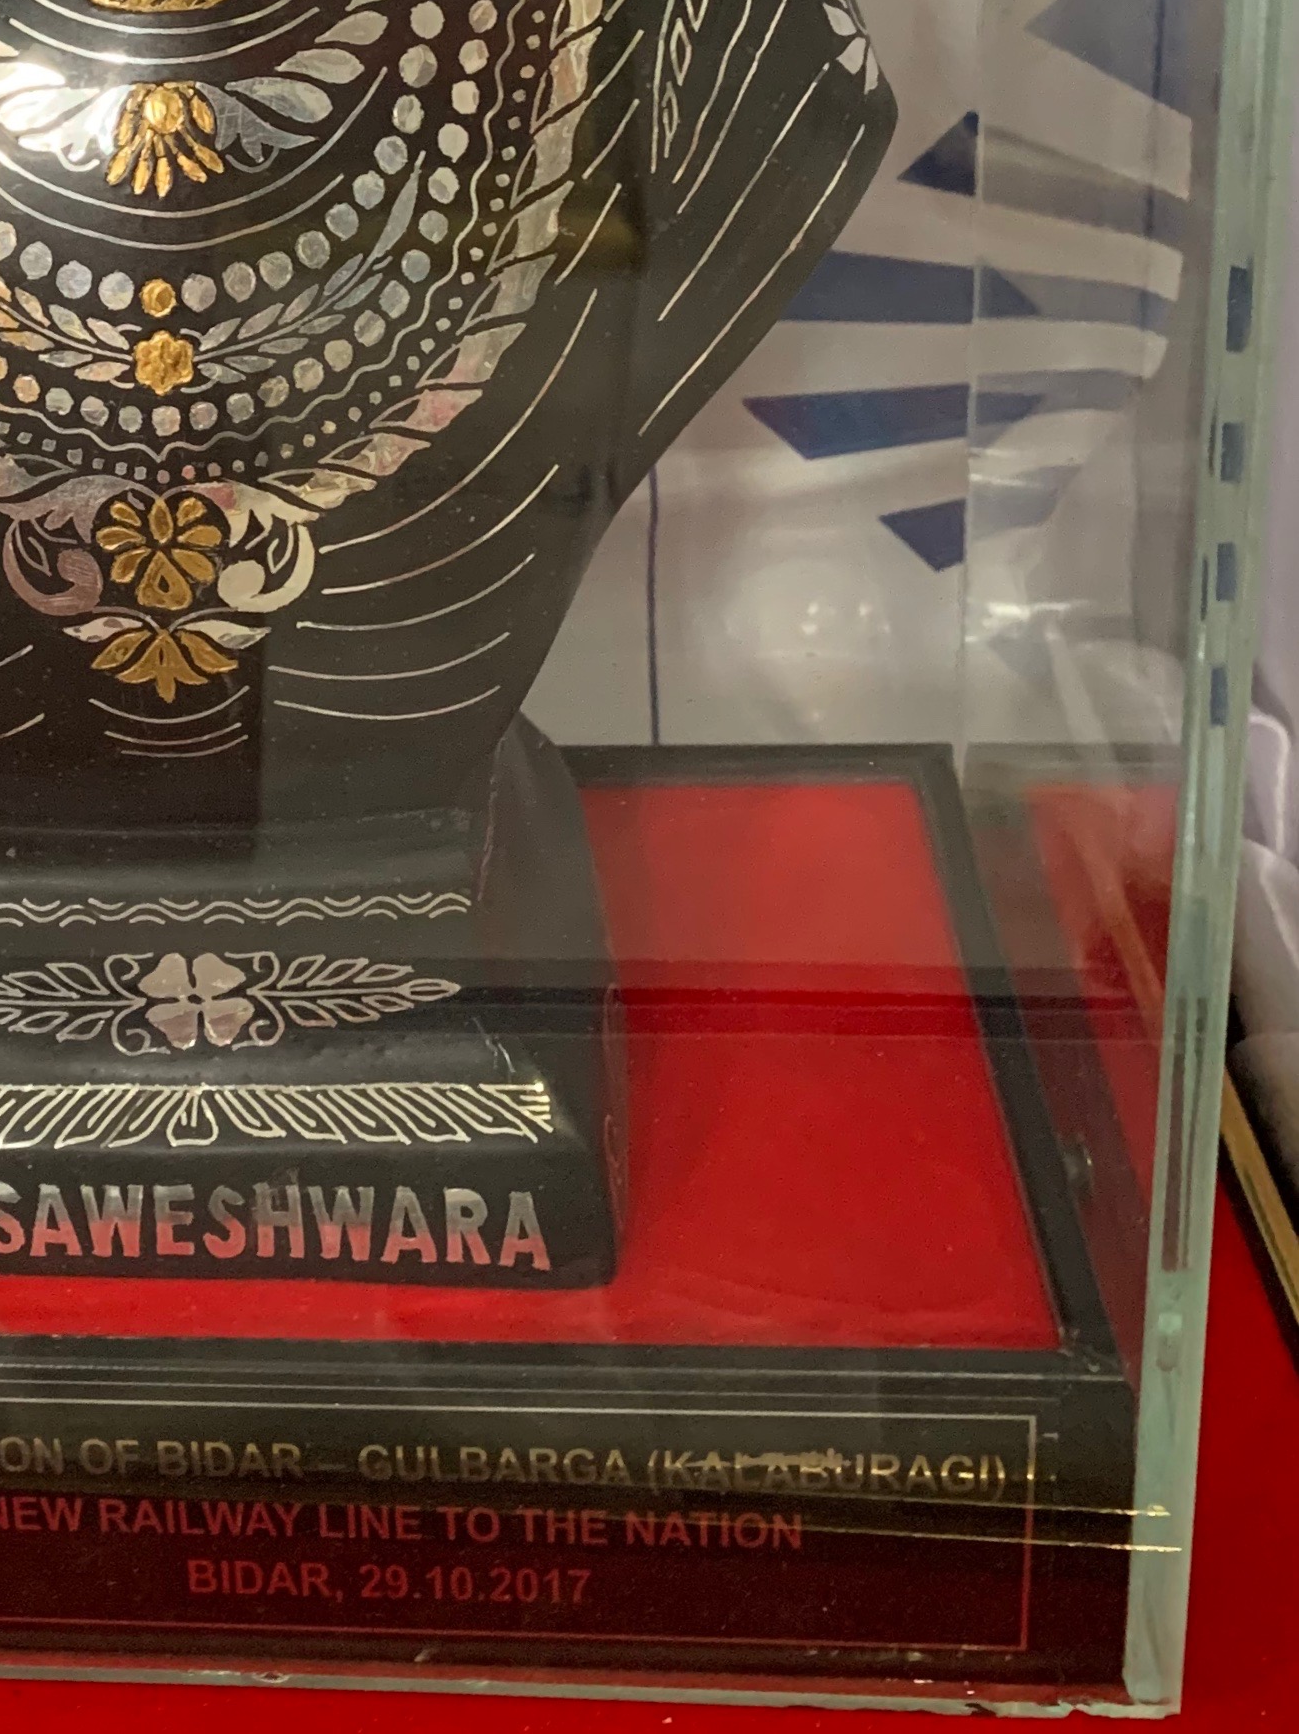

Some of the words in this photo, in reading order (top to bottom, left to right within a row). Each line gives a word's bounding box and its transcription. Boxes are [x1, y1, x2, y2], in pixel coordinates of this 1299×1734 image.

[79, 1438, 139, 1475] OF
[156, 1440, 302, 1478] BIDAR
[357, 1444, 632, 1485] GULBARGA
[101, 1498, 301, 1537] RAILWAY
[318, 1503, 423, 1541] LINE
[437, 1506, 501, 1543] TO
[516, 1507, 608, 1546] THE
[625, 1510, 802, 1550] NATION
[187, 1559, 344, 1603] BIDAR,
[358, 1564, 591, 1604] 29.10.2017
